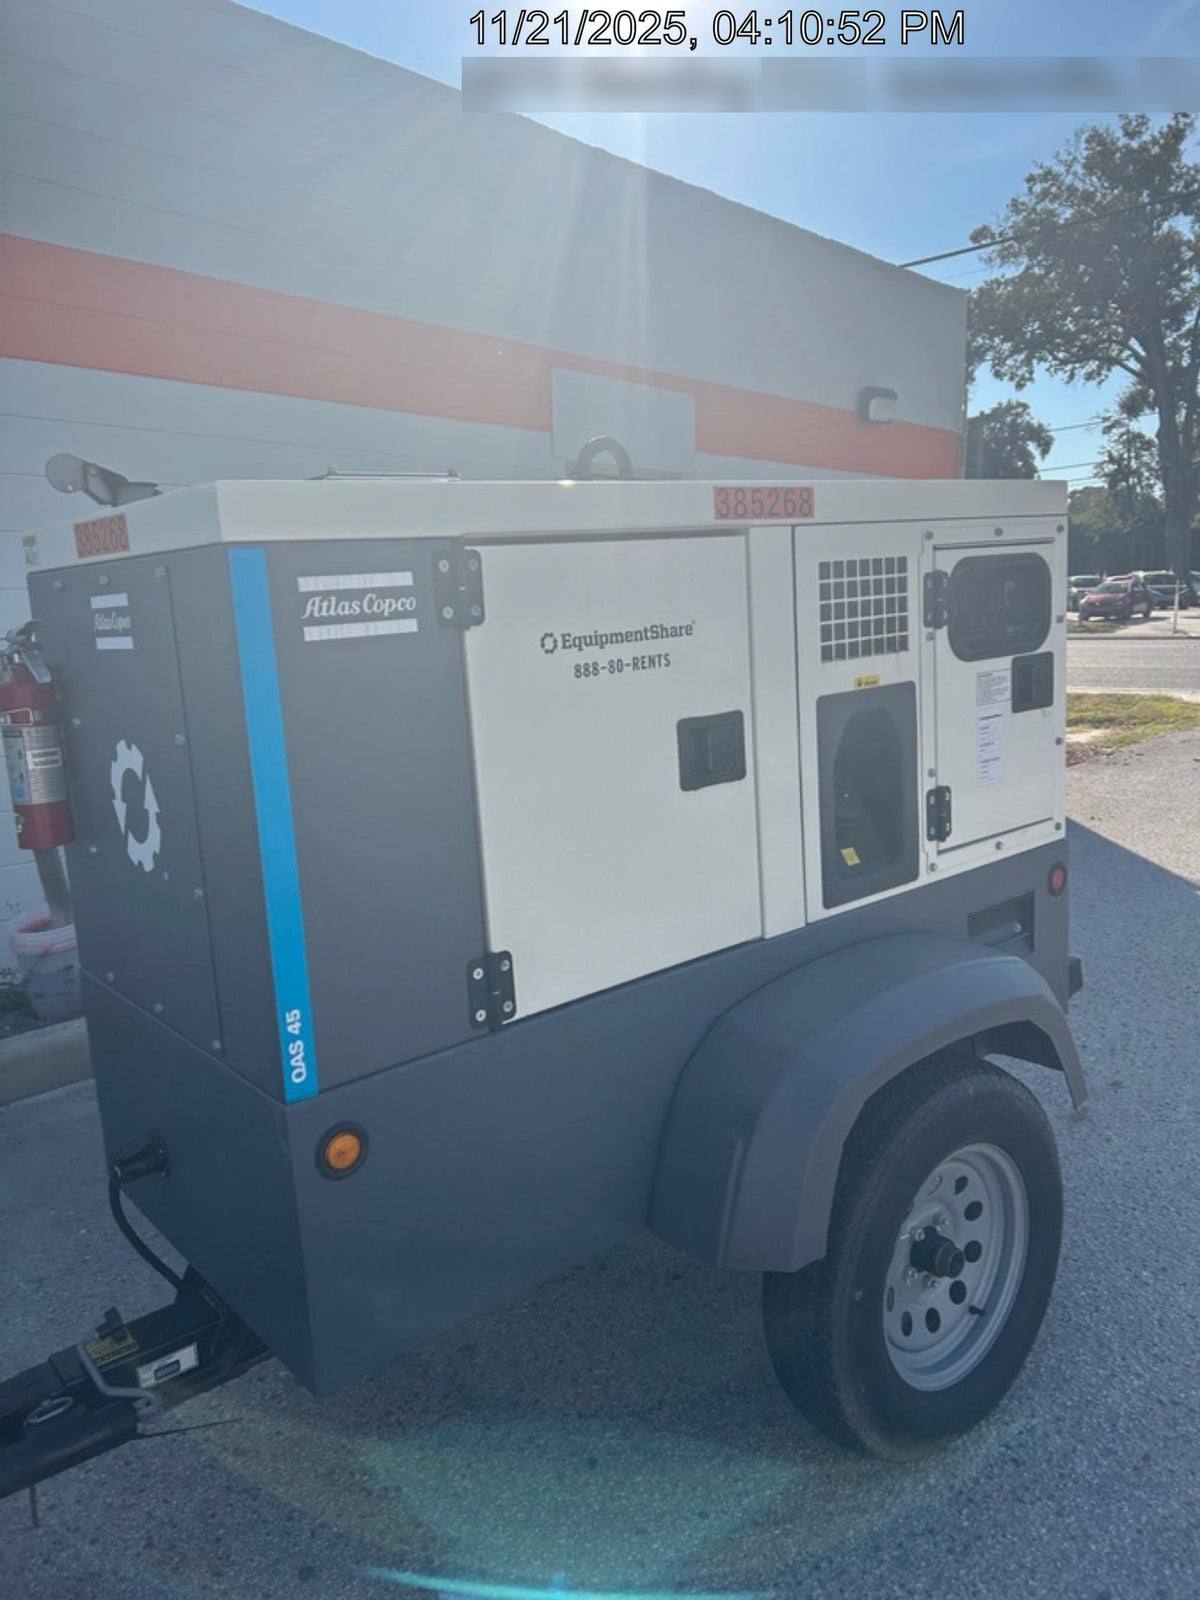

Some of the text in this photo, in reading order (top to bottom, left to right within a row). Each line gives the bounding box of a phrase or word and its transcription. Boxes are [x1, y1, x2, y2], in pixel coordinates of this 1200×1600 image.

[717, 487, 812, 518] 385268
[301, 593, 417, 620] Atlas Copco
[560, 623, 694, 651] EquipmentShare
[573, 653, 671, 679] 888-80-RENTS
[285, 1009, 307, 1083] QAS 45
